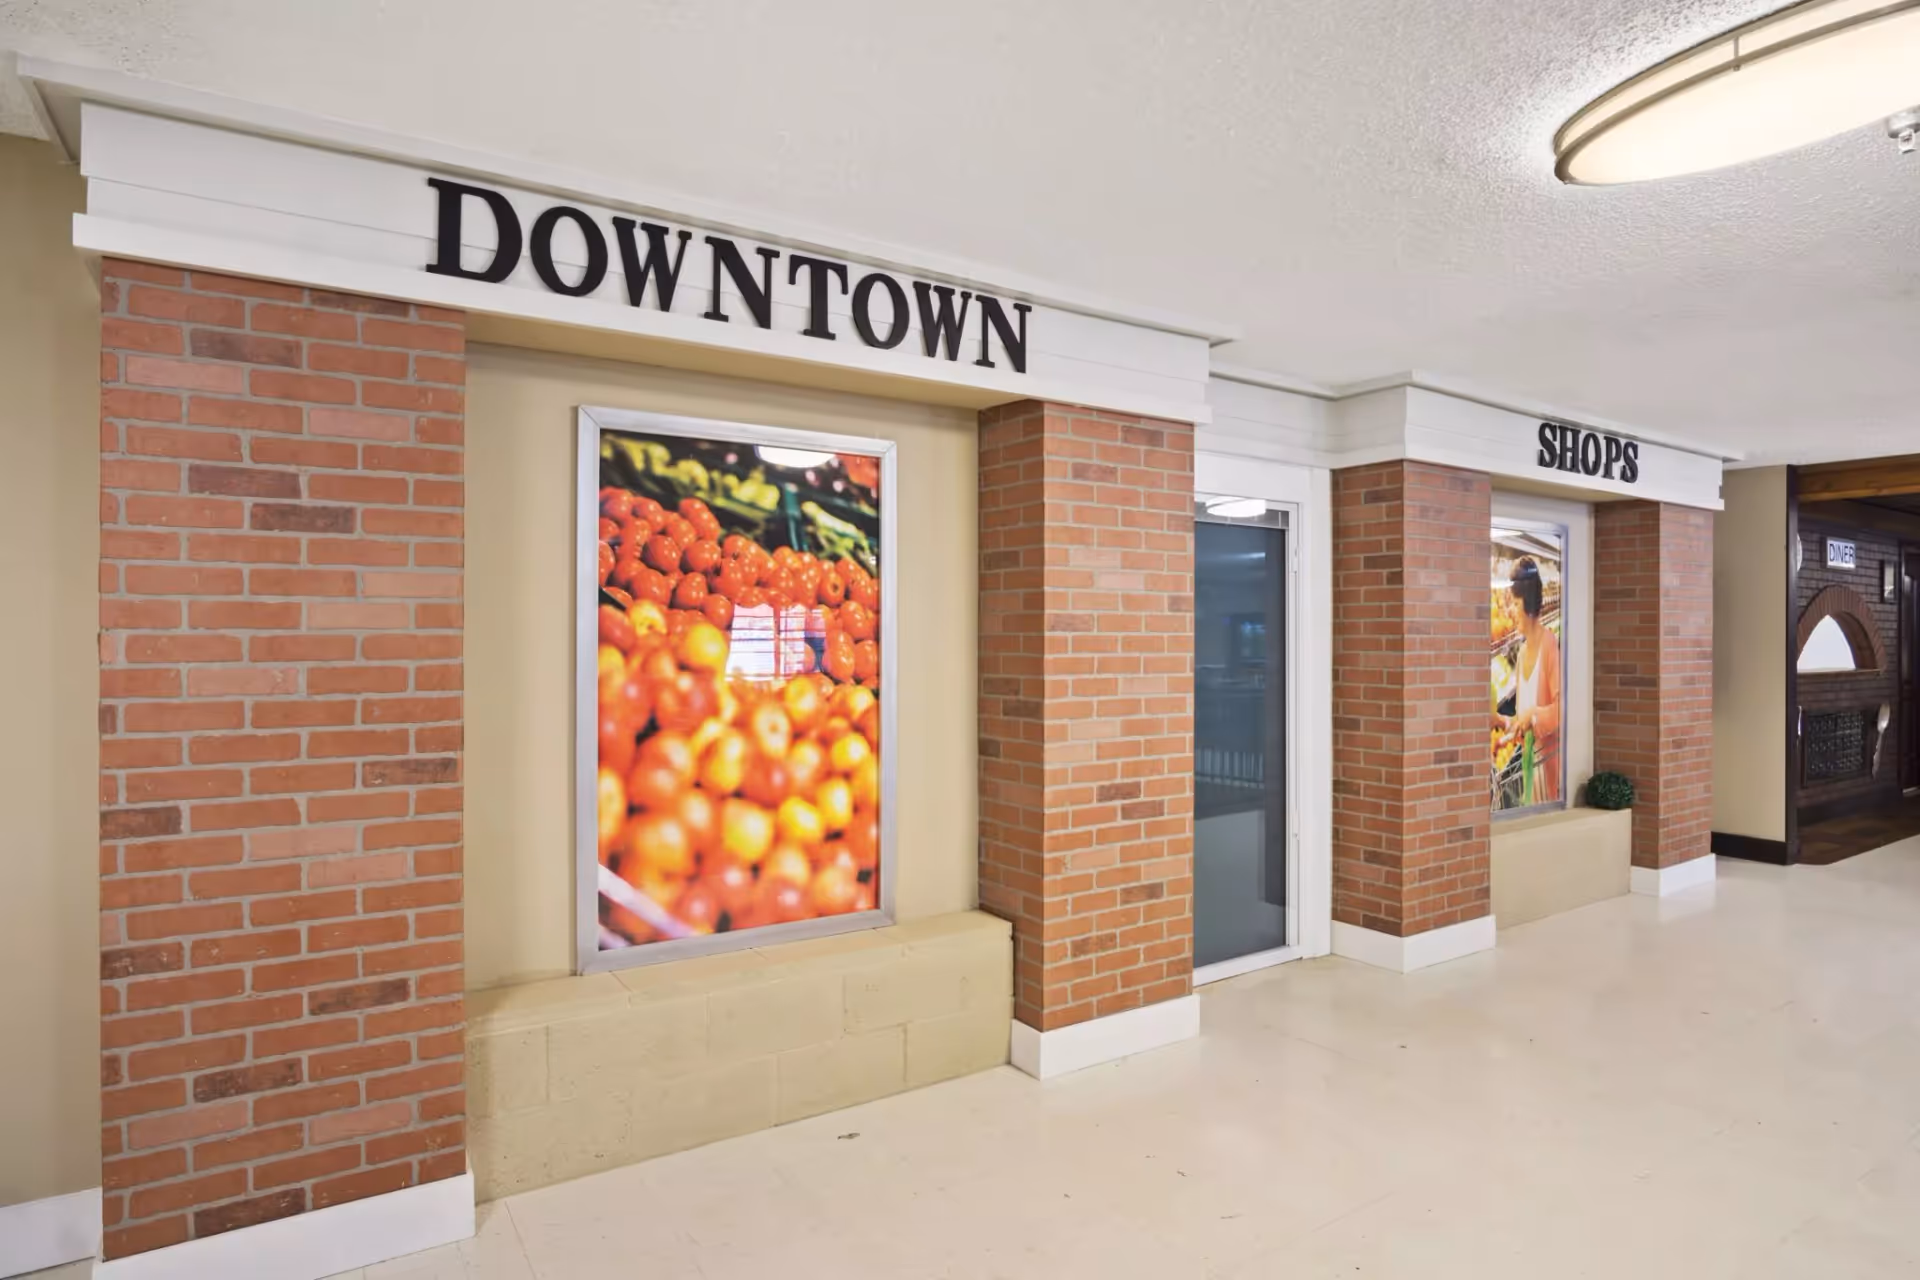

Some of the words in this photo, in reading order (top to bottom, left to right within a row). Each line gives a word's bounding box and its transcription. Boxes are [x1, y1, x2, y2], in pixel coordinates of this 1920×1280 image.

[426, 177, 1032, 374] DOWNTOWN
[1538, 422, 1638, 483] SHOPS
[1829, 543, 1855, 564] DINER
